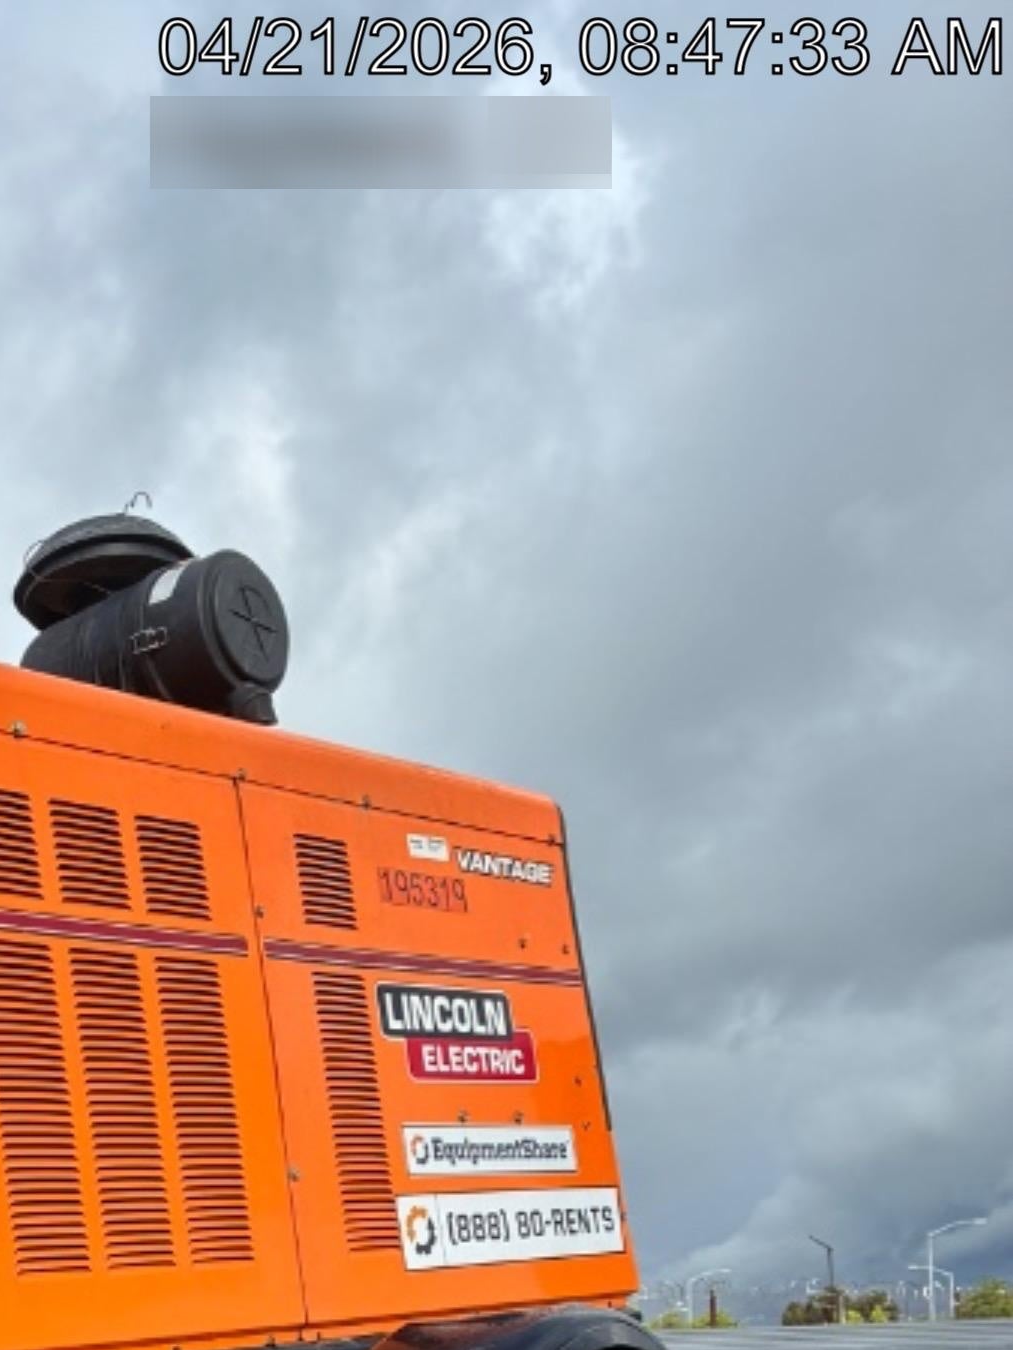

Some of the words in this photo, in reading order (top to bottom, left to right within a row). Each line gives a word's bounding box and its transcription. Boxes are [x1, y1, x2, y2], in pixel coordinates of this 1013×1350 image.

[456, 850, 552, 885] VANTAGE
[378, 867, 468, 912] 195319
[384, 992, 507, 1035] LINCOLN
[422, 1045, 525, 1075] ELECTRIC
[432, 1138, 568, 1166] EquipmentShare
[447, 1208, 510, 1246] (888)
[516, 1206, 615, 1238] 80-RENTS
